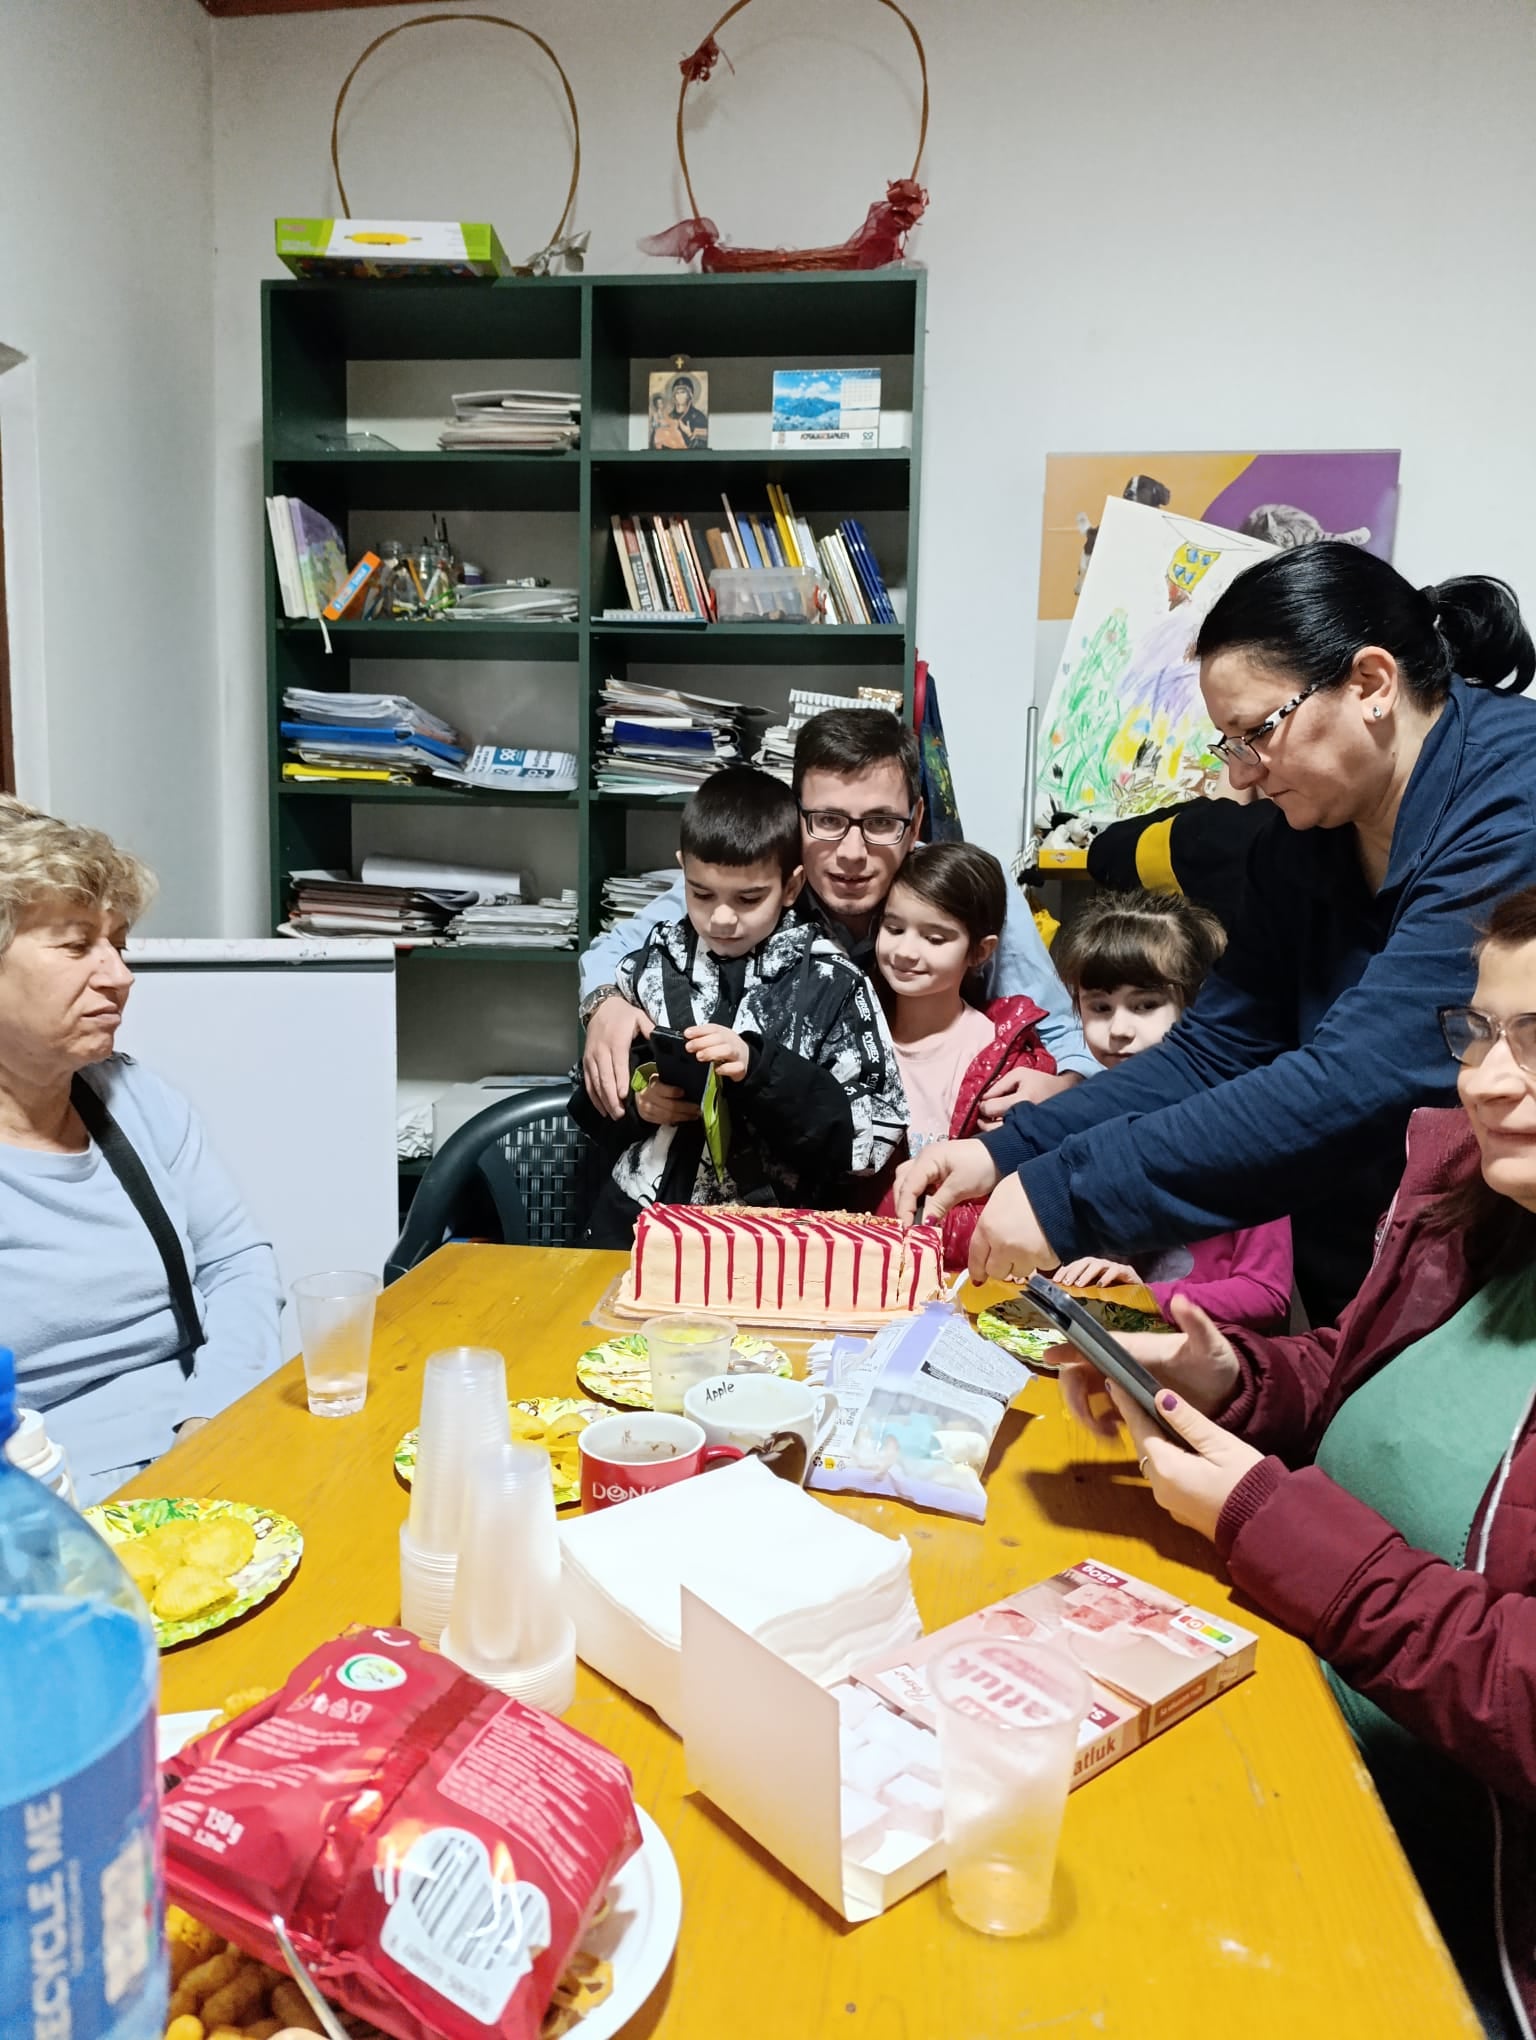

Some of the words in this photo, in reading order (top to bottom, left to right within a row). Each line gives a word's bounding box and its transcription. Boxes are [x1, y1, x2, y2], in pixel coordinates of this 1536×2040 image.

[862, 1031, 880, 1063] KYIREX
[705, 1382, 734, 1405] Apple
[1082, 1565, 1118, 1585] 450g
[950, 1657, 1050, 1720] atluk
[1073, 1736, 1115, 1776] atluk
[24, 1791, 63, 1874] ME
[27, 1870, 72, 2040] ECYCLE
